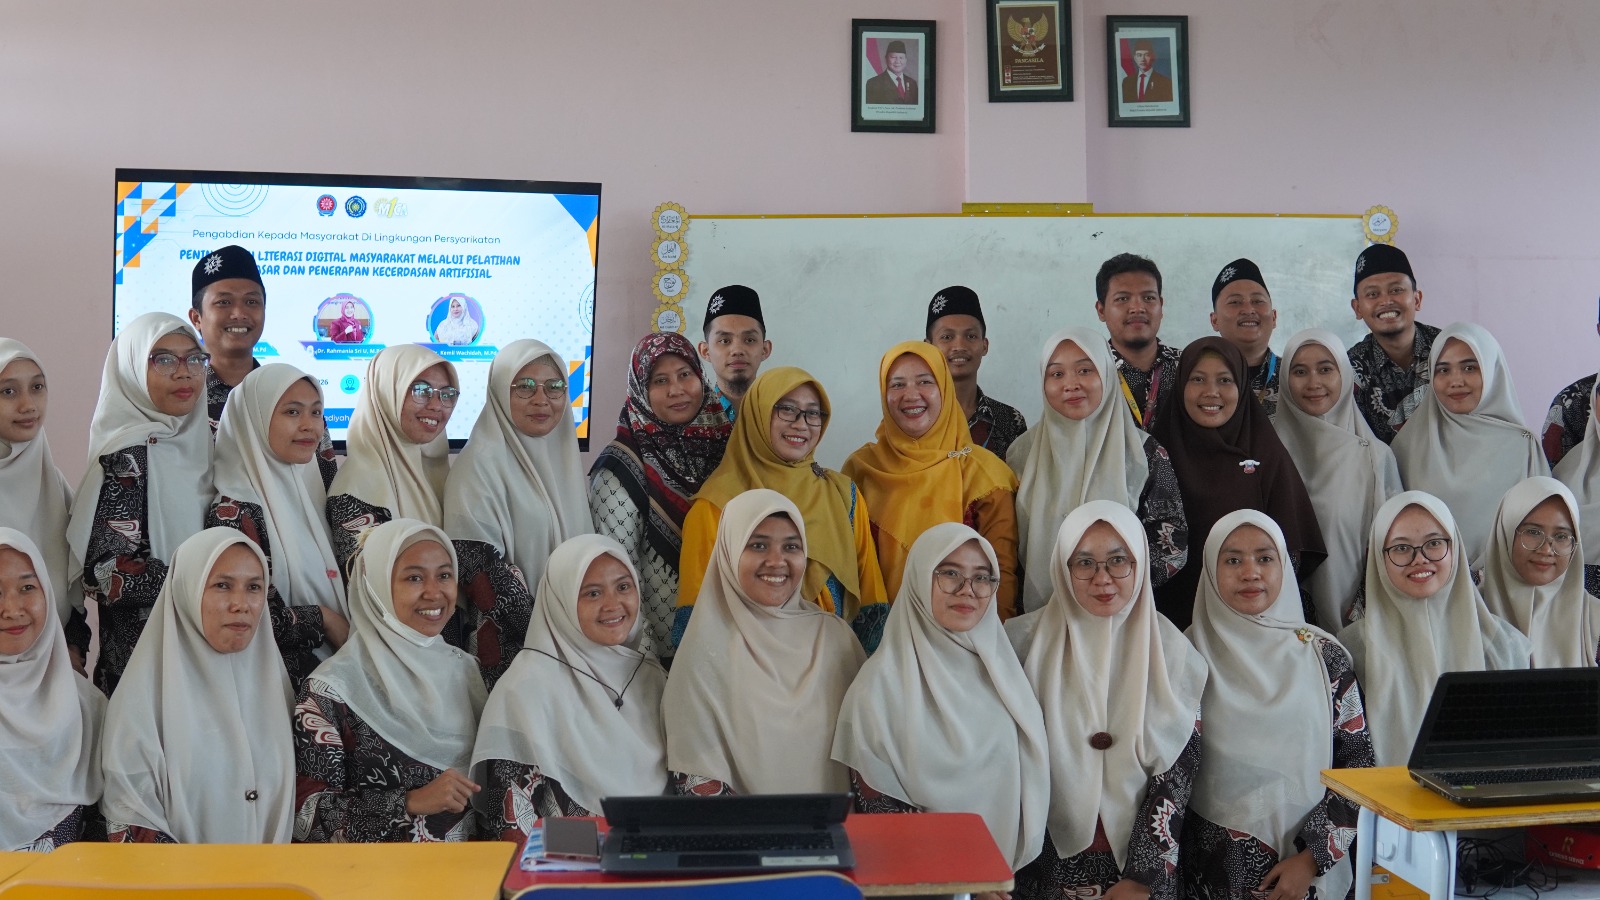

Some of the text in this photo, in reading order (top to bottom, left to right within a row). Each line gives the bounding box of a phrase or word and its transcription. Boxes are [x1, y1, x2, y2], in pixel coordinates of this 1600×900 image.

[192, 229, 501, 245] Pengabdian Kepada Masyarakat Di Lingkungan Persyarikatan
[257, 250, 303, 262] LITERASI
[305, 251, 347, 263] DIGITAL
[349, 252, 416, 264] MASYARAKAT
[417, 253, 464, 265] MELALUI
[466, 254, 521, 266] PELATIHAN
[283, 265, 306, 276] DAN
[308, 265, 370, 277] PENERAPAN
[372, 266, 437, 278] KECERDASAN
[438, 267, 493, 279] ARTIFISIAL
